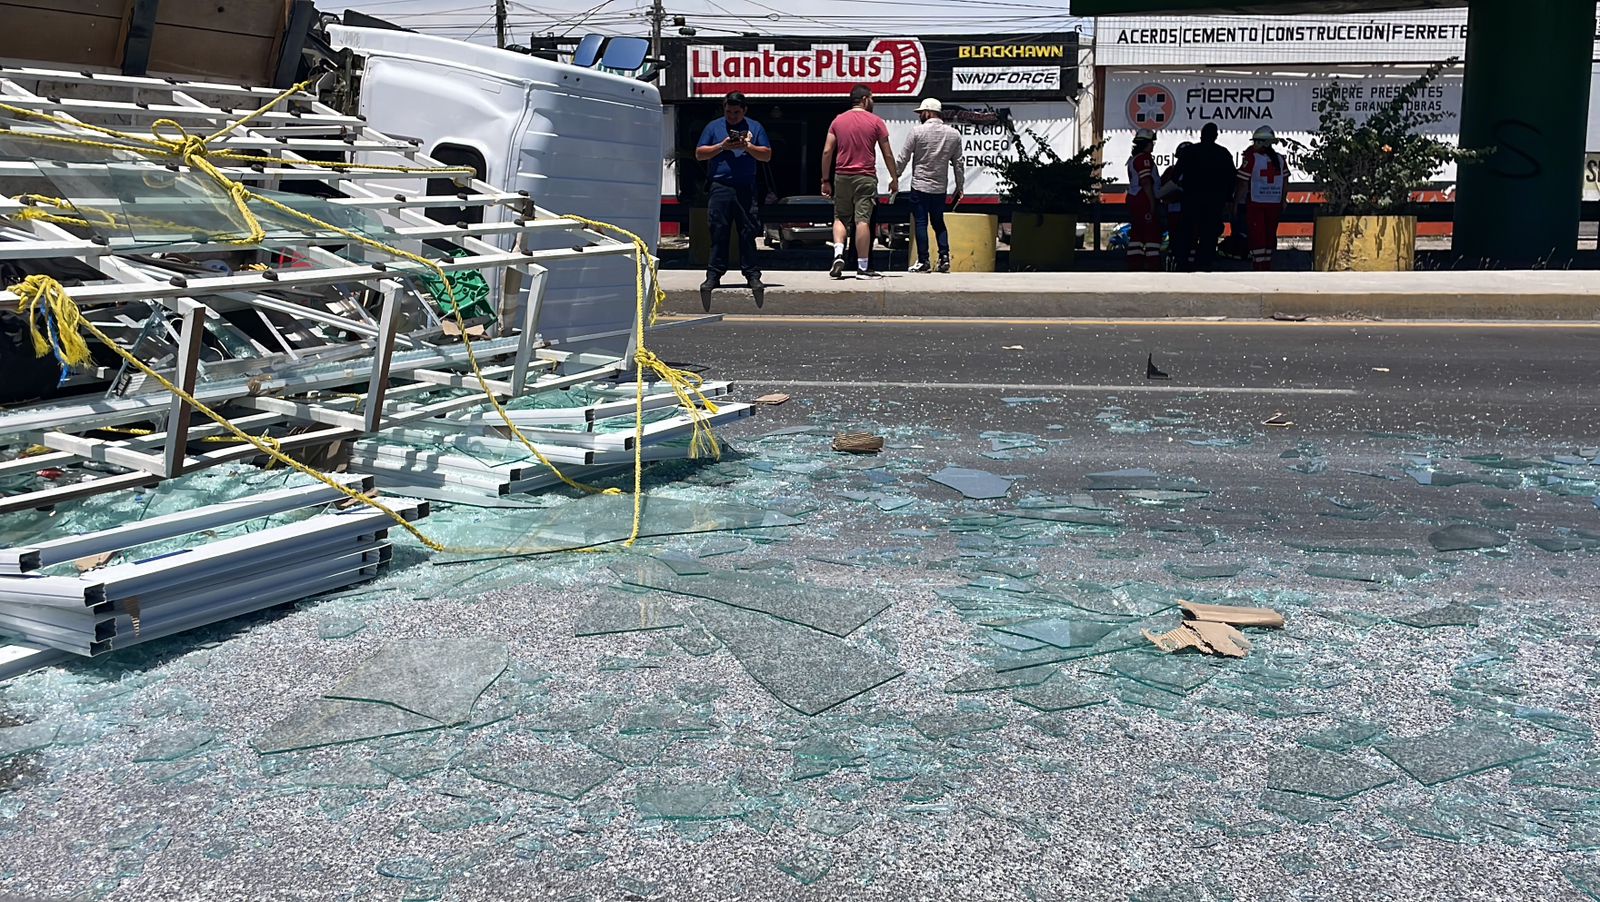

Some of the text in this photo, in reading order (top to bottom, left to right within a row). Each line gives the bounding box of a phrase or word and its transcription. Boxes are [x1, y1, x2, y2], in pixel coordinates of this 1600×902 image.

[1116, 19, 1468, 44] ACEROS CEMENTO CONSTRUCCIÓN FERRETE
[958, 45, 1064, 58] BLACKHAWN
[691, 49, 882, 78] LlantasPlus
[1371, 86, 1443, 99] PRESTES
[1406, 101, 1442, 111] OBRAS
[1186, 106, 1273, 120] Y LAMINA
[964, 140, 1009, 151] ANCEO
